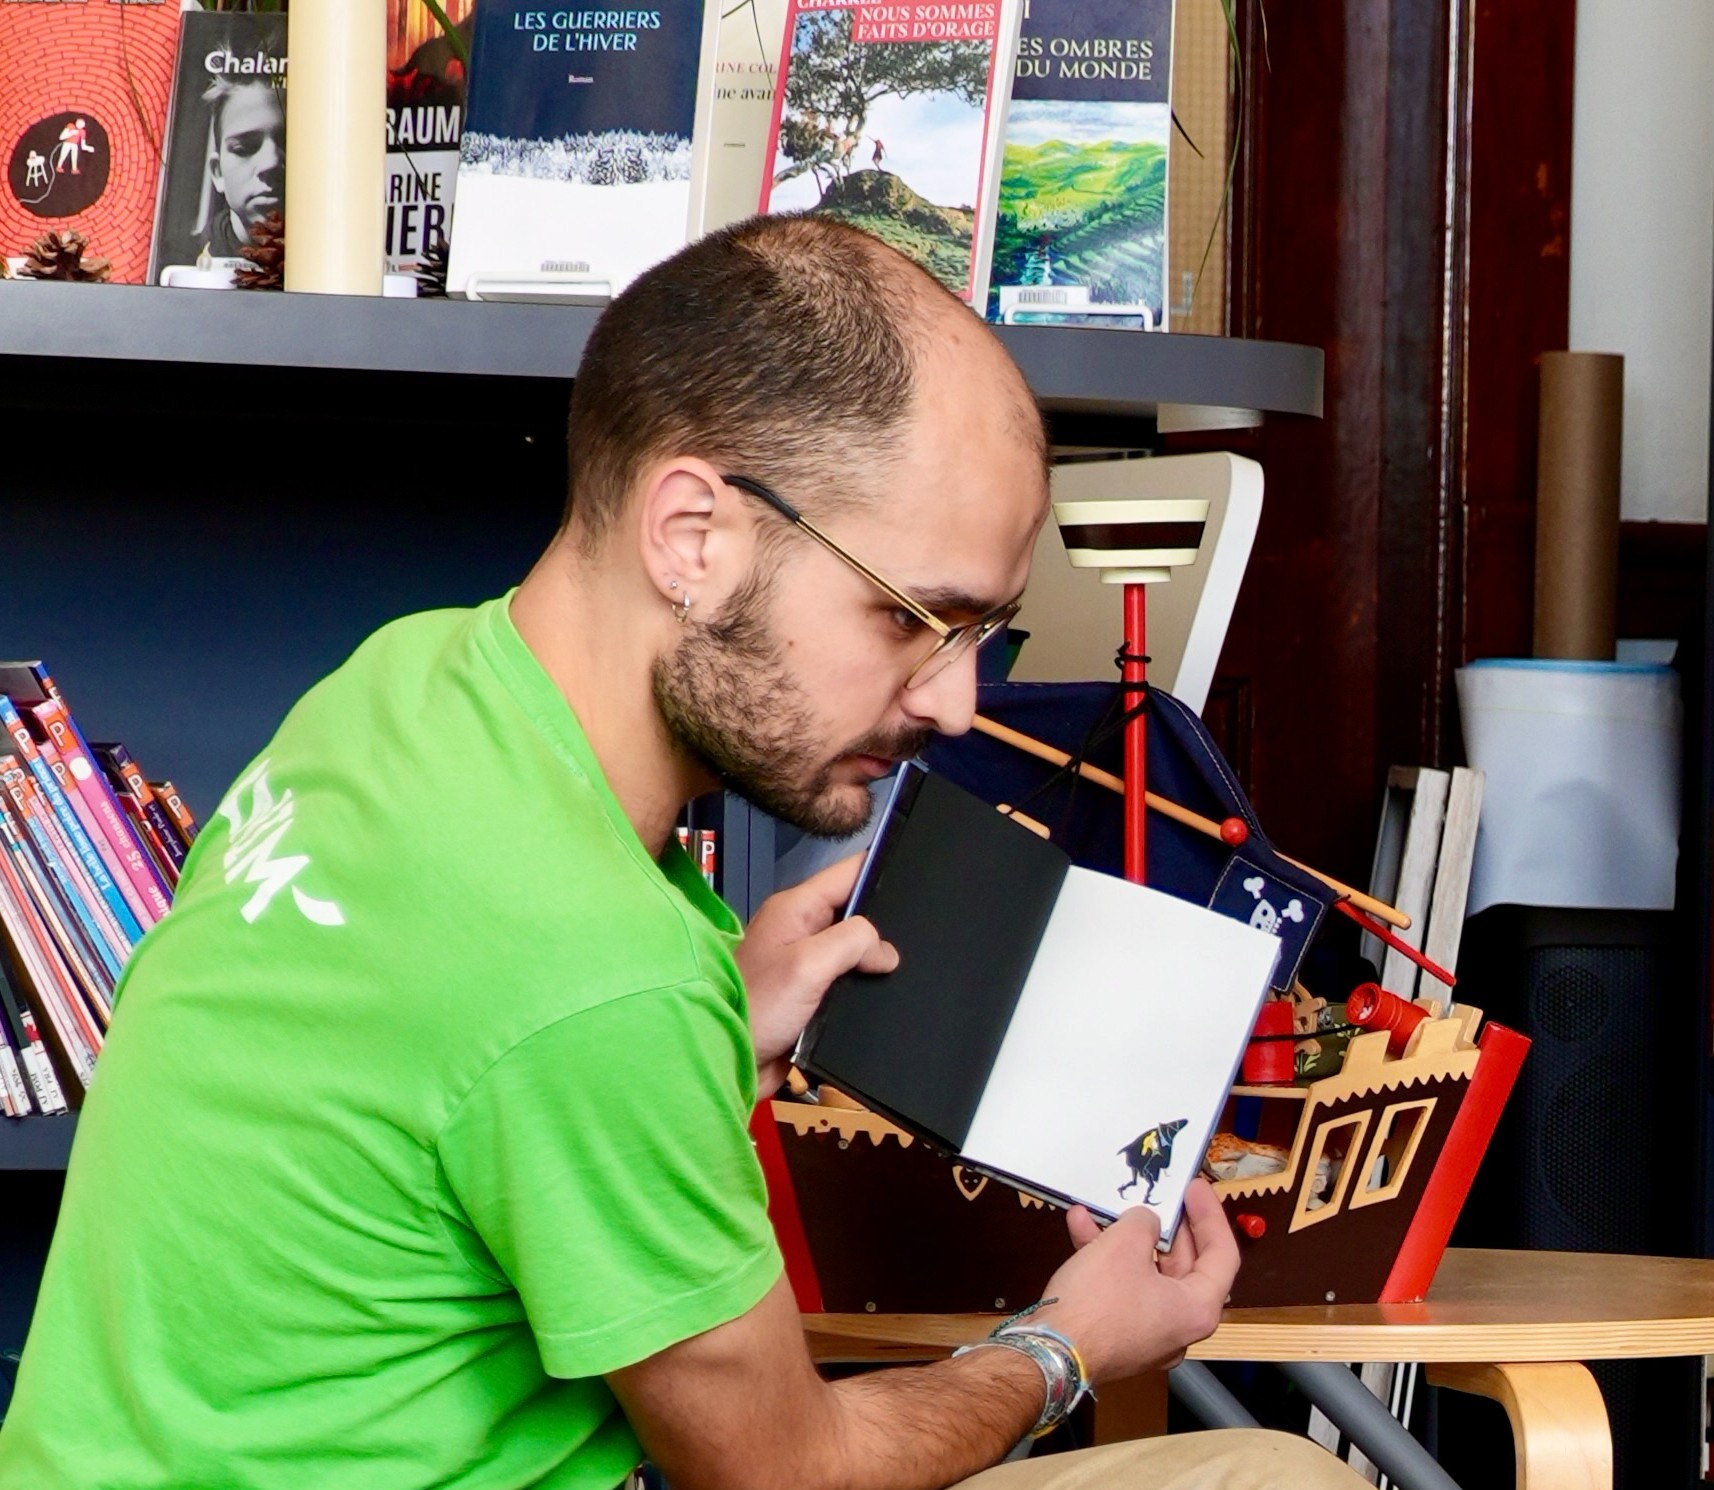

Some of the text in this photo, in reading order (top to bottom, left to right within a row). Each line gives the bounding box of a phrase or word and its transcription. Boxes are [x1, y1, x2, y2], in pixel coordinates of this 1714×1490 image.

[514, 11, 661, 30] LES GUERRIERS
[859, 4, 995, 21] NOUS SOMMES
[533, 33, 637, 51] DE L'HIVER
[857, 20, 995, 40] FAITS D'ORAGE
[1017, 38, 1153, 59] ES OMBRES
[1016, 59, 1152, 80] DU MONDE
[385, 172, 442, 203] RINE
[14, 727, 31, 754] P
[49, 721, 66, 747] P
[51, 761, 67, 787] P
[127, 773, 144, 799] P
[167, 795, 183, 820] P
[101, 801, 144, 871] 25 chansons
[702, 841, 715, 864] P
